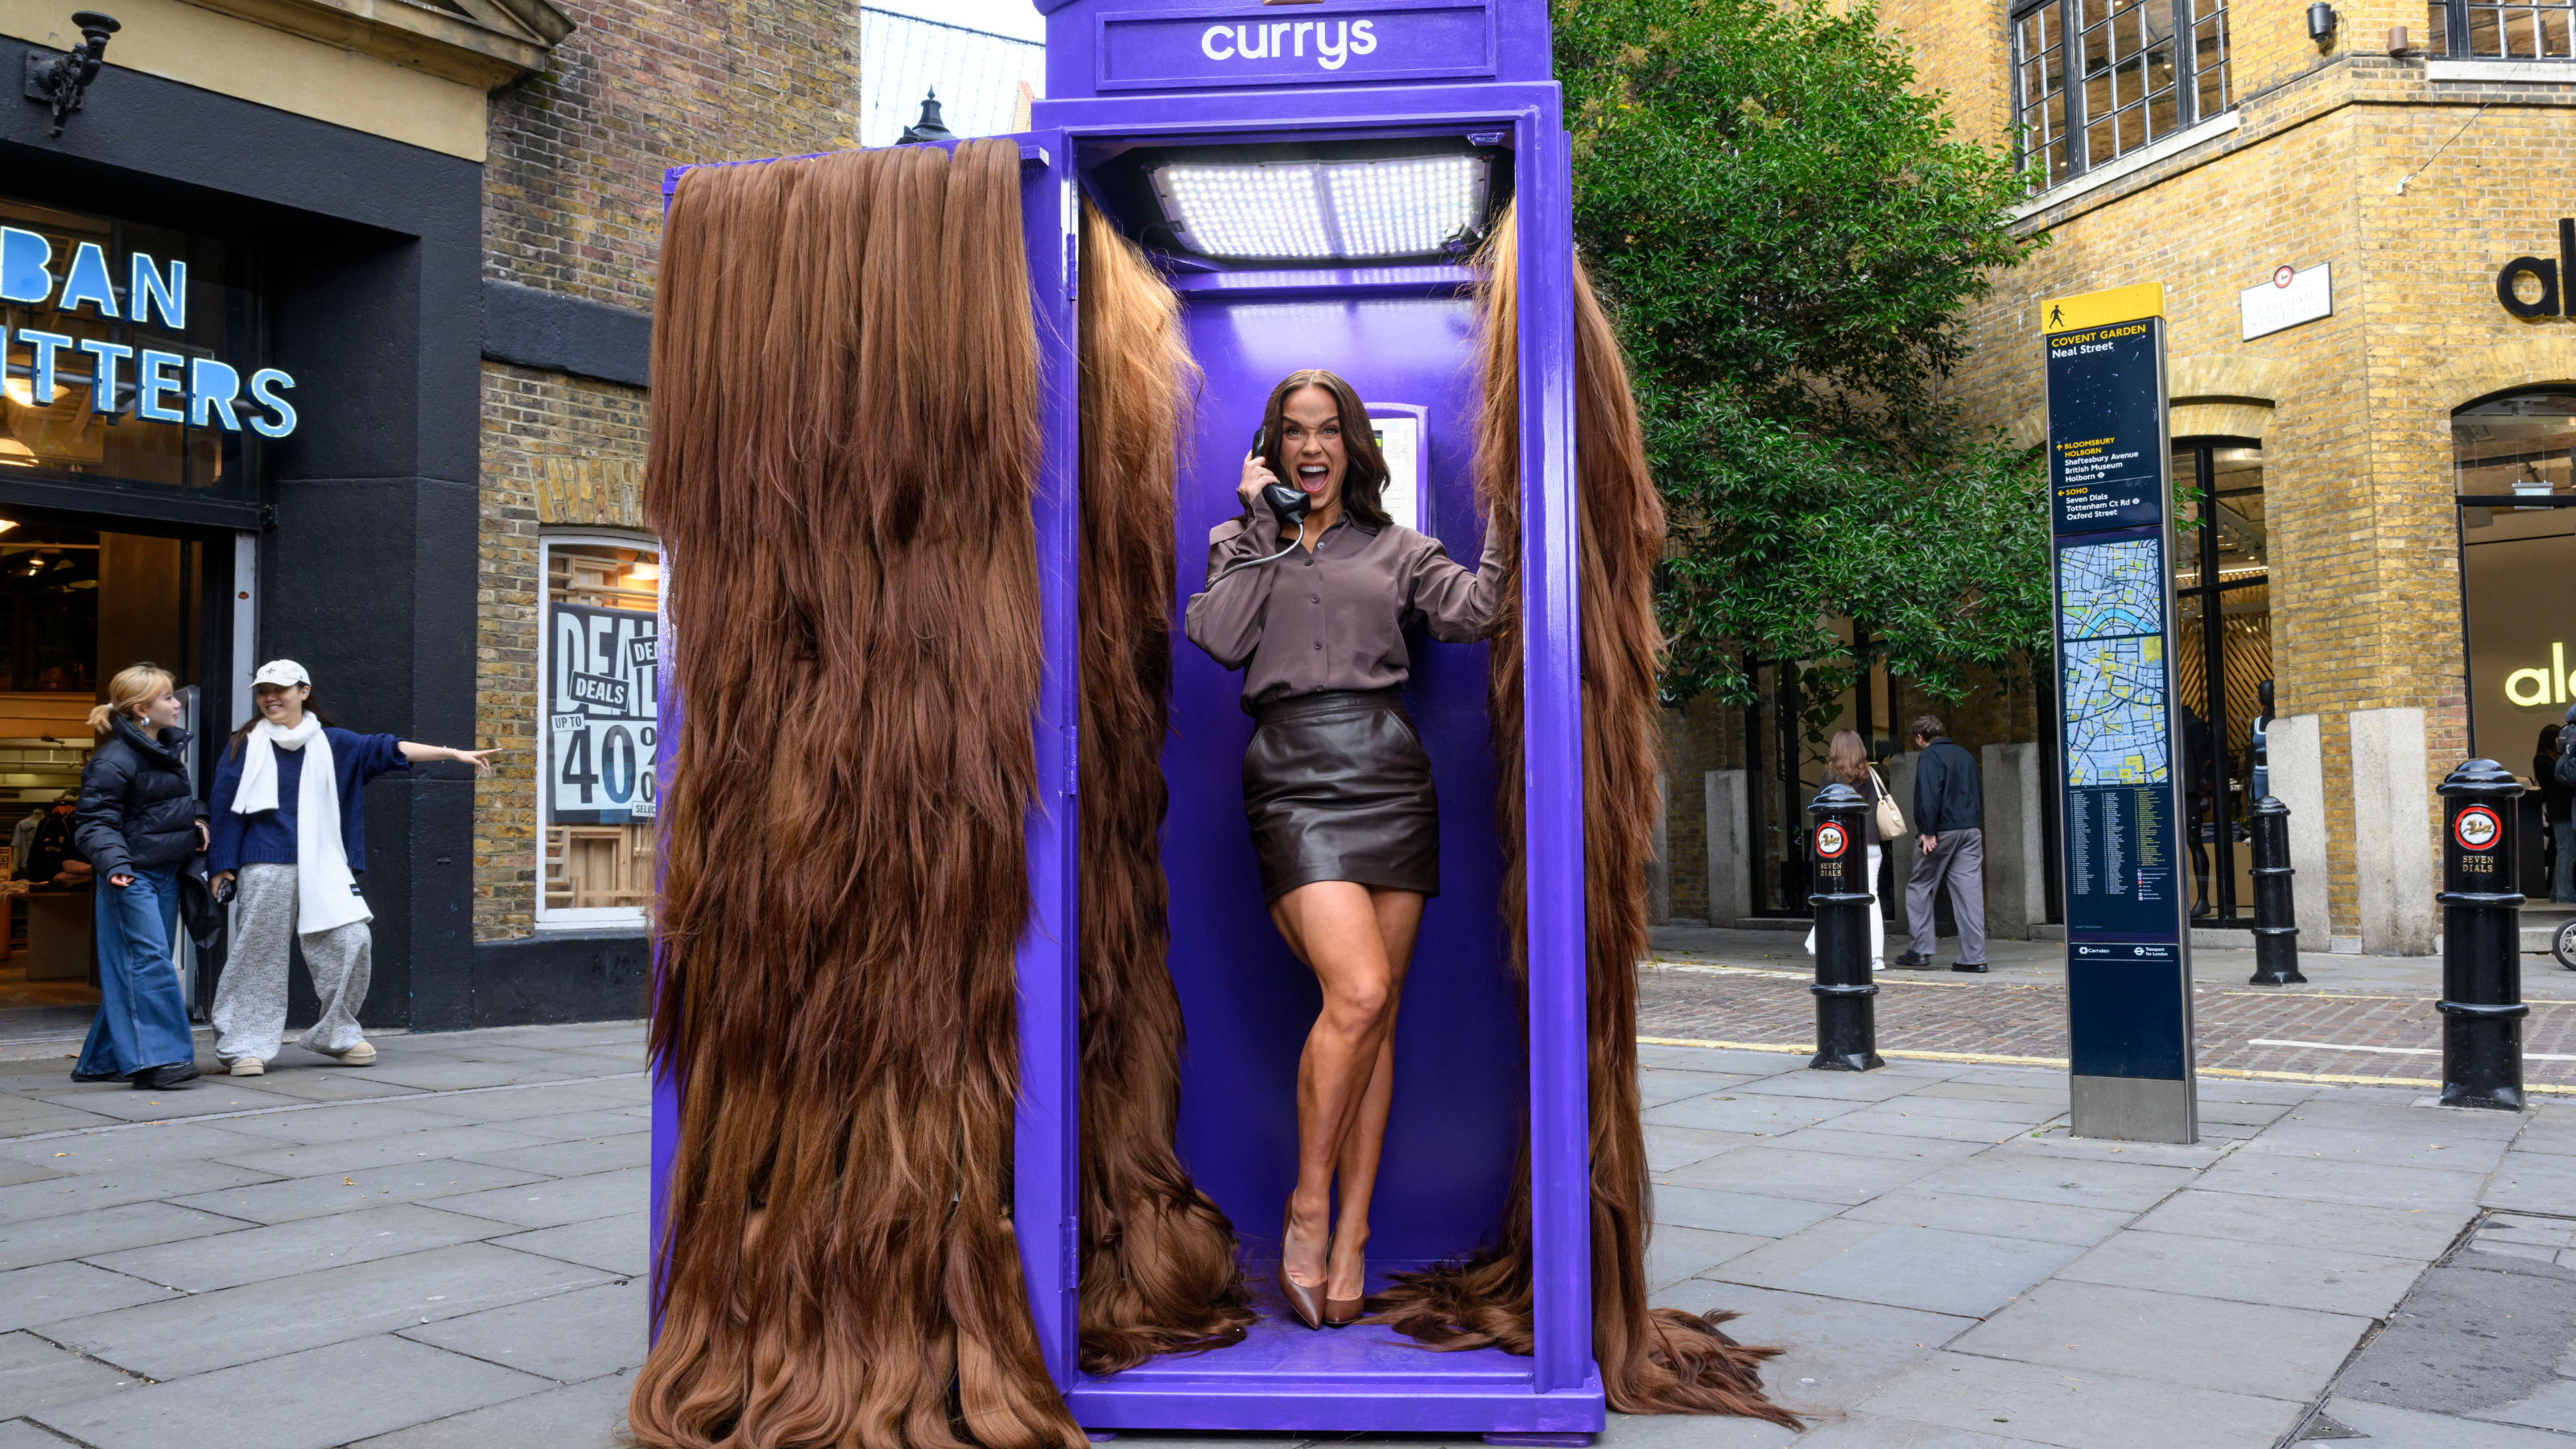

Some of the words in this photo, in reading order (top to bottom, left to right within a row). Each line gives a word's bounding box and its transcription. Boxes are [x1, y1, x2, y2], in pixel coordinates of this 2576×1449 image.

[1201, 19, 1377, 70] currys
[2496, 217, 2576, 318] al
[0, 225, 187, 332] BAN
[2257, 291, 2314, 316] EARLHAM
[2252, 308, 2297, 330] STREET
[2300, 302, 2320, 315] WC2
[2051, 332, 2096, 347] COVENT
[2099, 324, 2146, 340] GARDEN
[2052, 346, 2077, 358] Neal
[2080, 341, 2114, 354] Street
[2064, 437, 2116, 449] BLOOMSBURY
[2064, 448, 2102, 457] HOLBORN
[2064, 456, 2109, 466] Shaftesbury
[2111, 452, 2139, 460] Avenue
[2065, 465, 2089, 475] British
[2091, 462, 2123, 471] Museum
[2065, 473, 2095, 483] Holborn
[2066, 487, 2088, 496] SOHO
[2066, 496, 2087, 504] Seven
[2089, 493, 2108, 502] Dials
[2066, 502, 2107, 512] Tottenham
[2066, 511, 2092, 520] Oxford
[2095, 509, 2118, 518] Street
[2504, 642, 2576, 707] al
[575, 678, 625, 704] DEALS
[555, 716, 568, 729] UP
[568, 716, 582, 727] TO
[2462, 856, 2494, 864] SEVEN
[2462, 865, 2493, 873] DIALS
